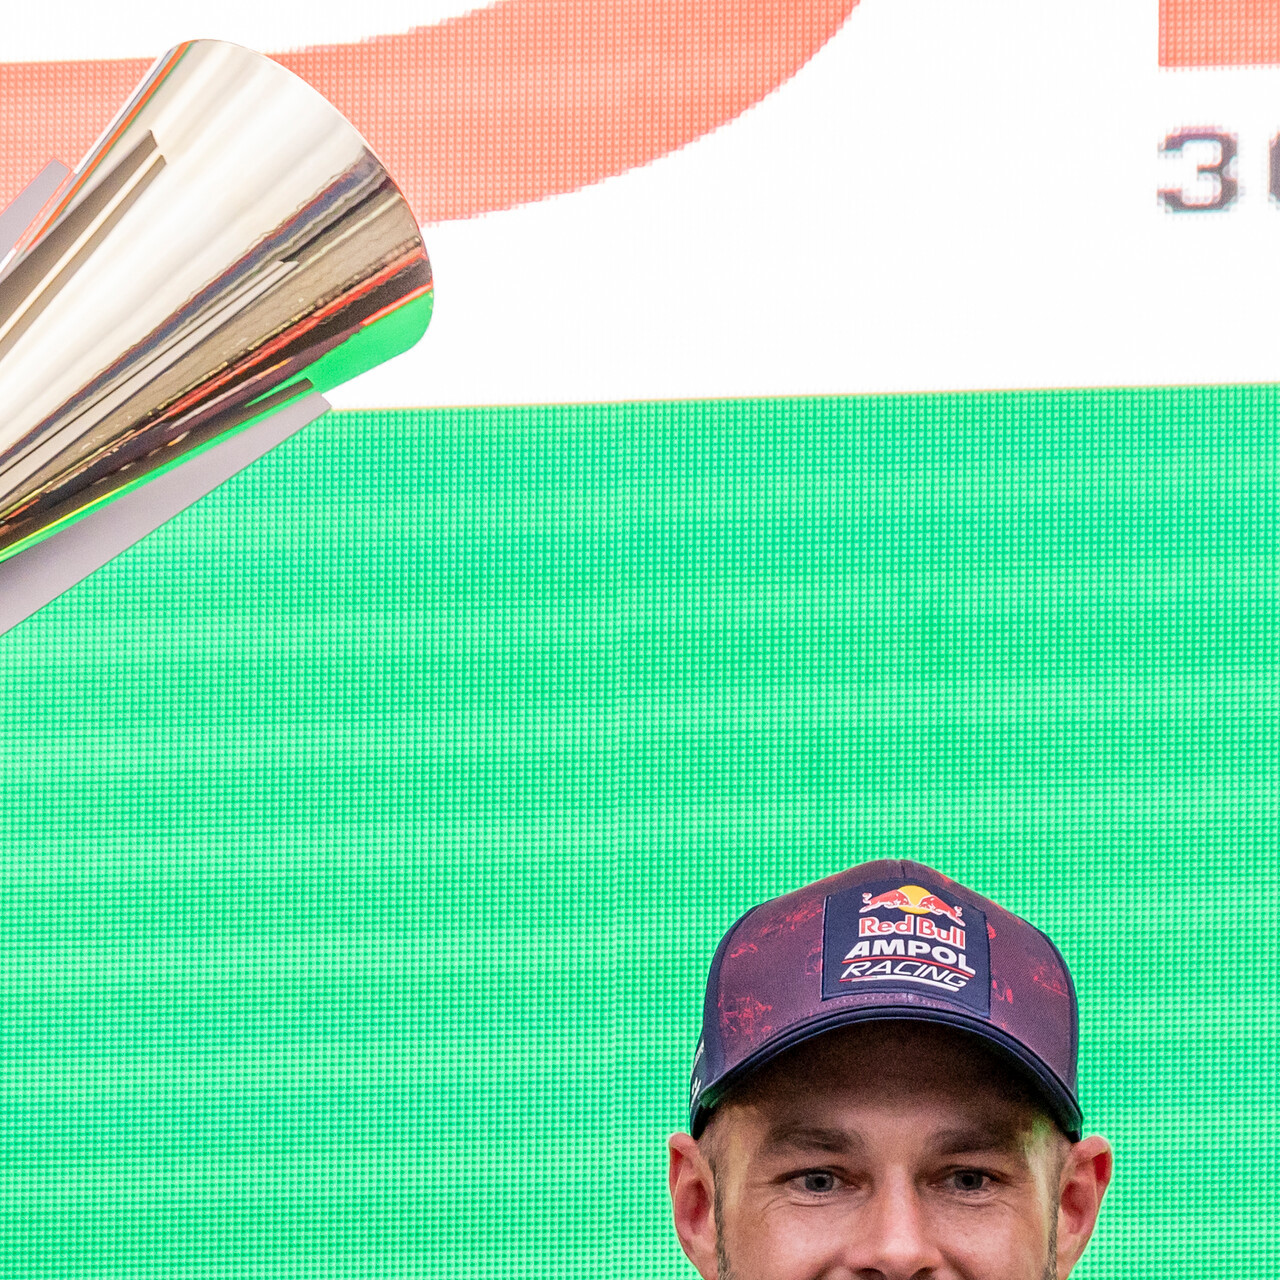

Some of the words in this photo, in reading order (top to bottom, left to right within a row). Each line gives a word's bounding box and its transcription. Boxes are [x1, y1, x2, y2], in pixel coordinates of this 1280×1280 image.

[858, 915, 917, 938] Red
[917, 916, 966, 950] Bull
[840, 960, 970, 988] RACING
[844, 939, 977, 976] AMPOL
